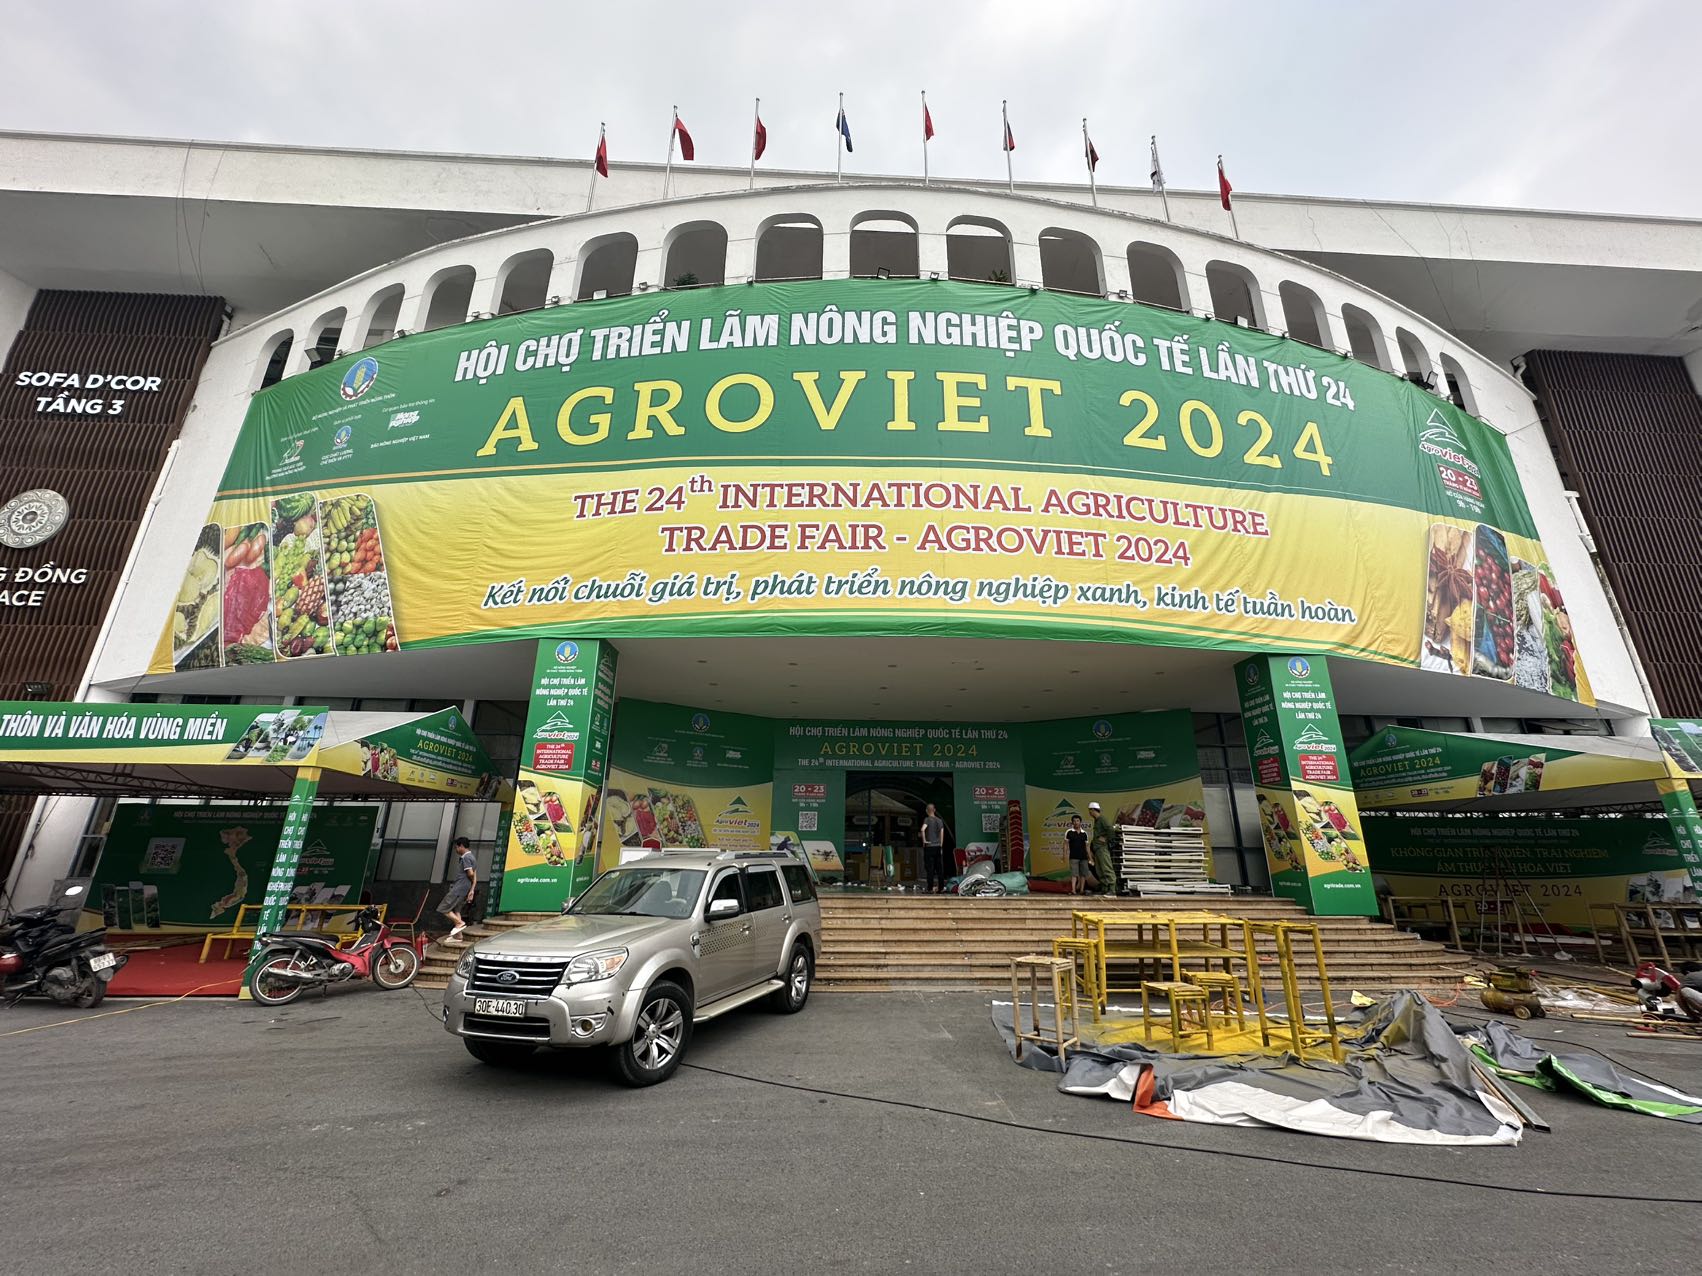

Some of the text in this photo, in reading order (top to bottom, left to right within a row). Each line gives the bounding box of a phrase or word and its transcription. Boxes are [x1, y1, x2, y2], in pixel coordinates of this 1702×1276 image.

[454, 305, 1356, 411] HỘI CHỢ TRIỂN LÃM NÔNG NGHIỆP QUỐC TẾ LẦN THỨ 24
[16, 371, 162, 392] SOFA D'COR
[35, 390, 126, 415] TẦNG 3
[476, 370, 1333, 477] AGROVIET 2024
[573, 489, 640, 519] THE
[719, 482, 1032, 512] INTERNATIONAL
[1041, 489, 1270, 536] AGRICULTURE
[661, 524, 788, 552] TRADE
[797, 523, 887, 550] FAIR
[917, 524, 1107, 558] AGROVIET
[1115, 535, 1191, 566] 2024
[14, 561, 88, 584] ĐỒNG
[485, 565, 1355, 623] Kết nối chuỗi giá trị, phát triển nông nghiệp xanh, kinh tế tuần hoàn
[0, 710, 228, 740] THÔN VÀ VĂN HÓA VÙNG MIỀN
[997, 729, 1008, 739] 24
[417, 739, 456, 758] AGROVIET
[820, 742, 978, 757] AGROVIET 2024
[826, 759, 873, 768] INTERNATIONAL
[874, 759, 914, 768] AGRICULTURE
[915, 760, 934, 768] TRADE
[935, 760, 950, 768] FAIR
[955, 760, 985, 769] AGROVIET
[985, 761, 1001, 770] 2024
[1360, 762, 1409, 777] AGROVIET
[1414, 756, 1441, 769] 2024
[794, 785, 806, 793] 20
[813, 785, 825, 793] 23
[975, 787, 986, 795] 20
[994, 787, 1005, 795] 23
[1541, 884, 1583, 897] 2024
